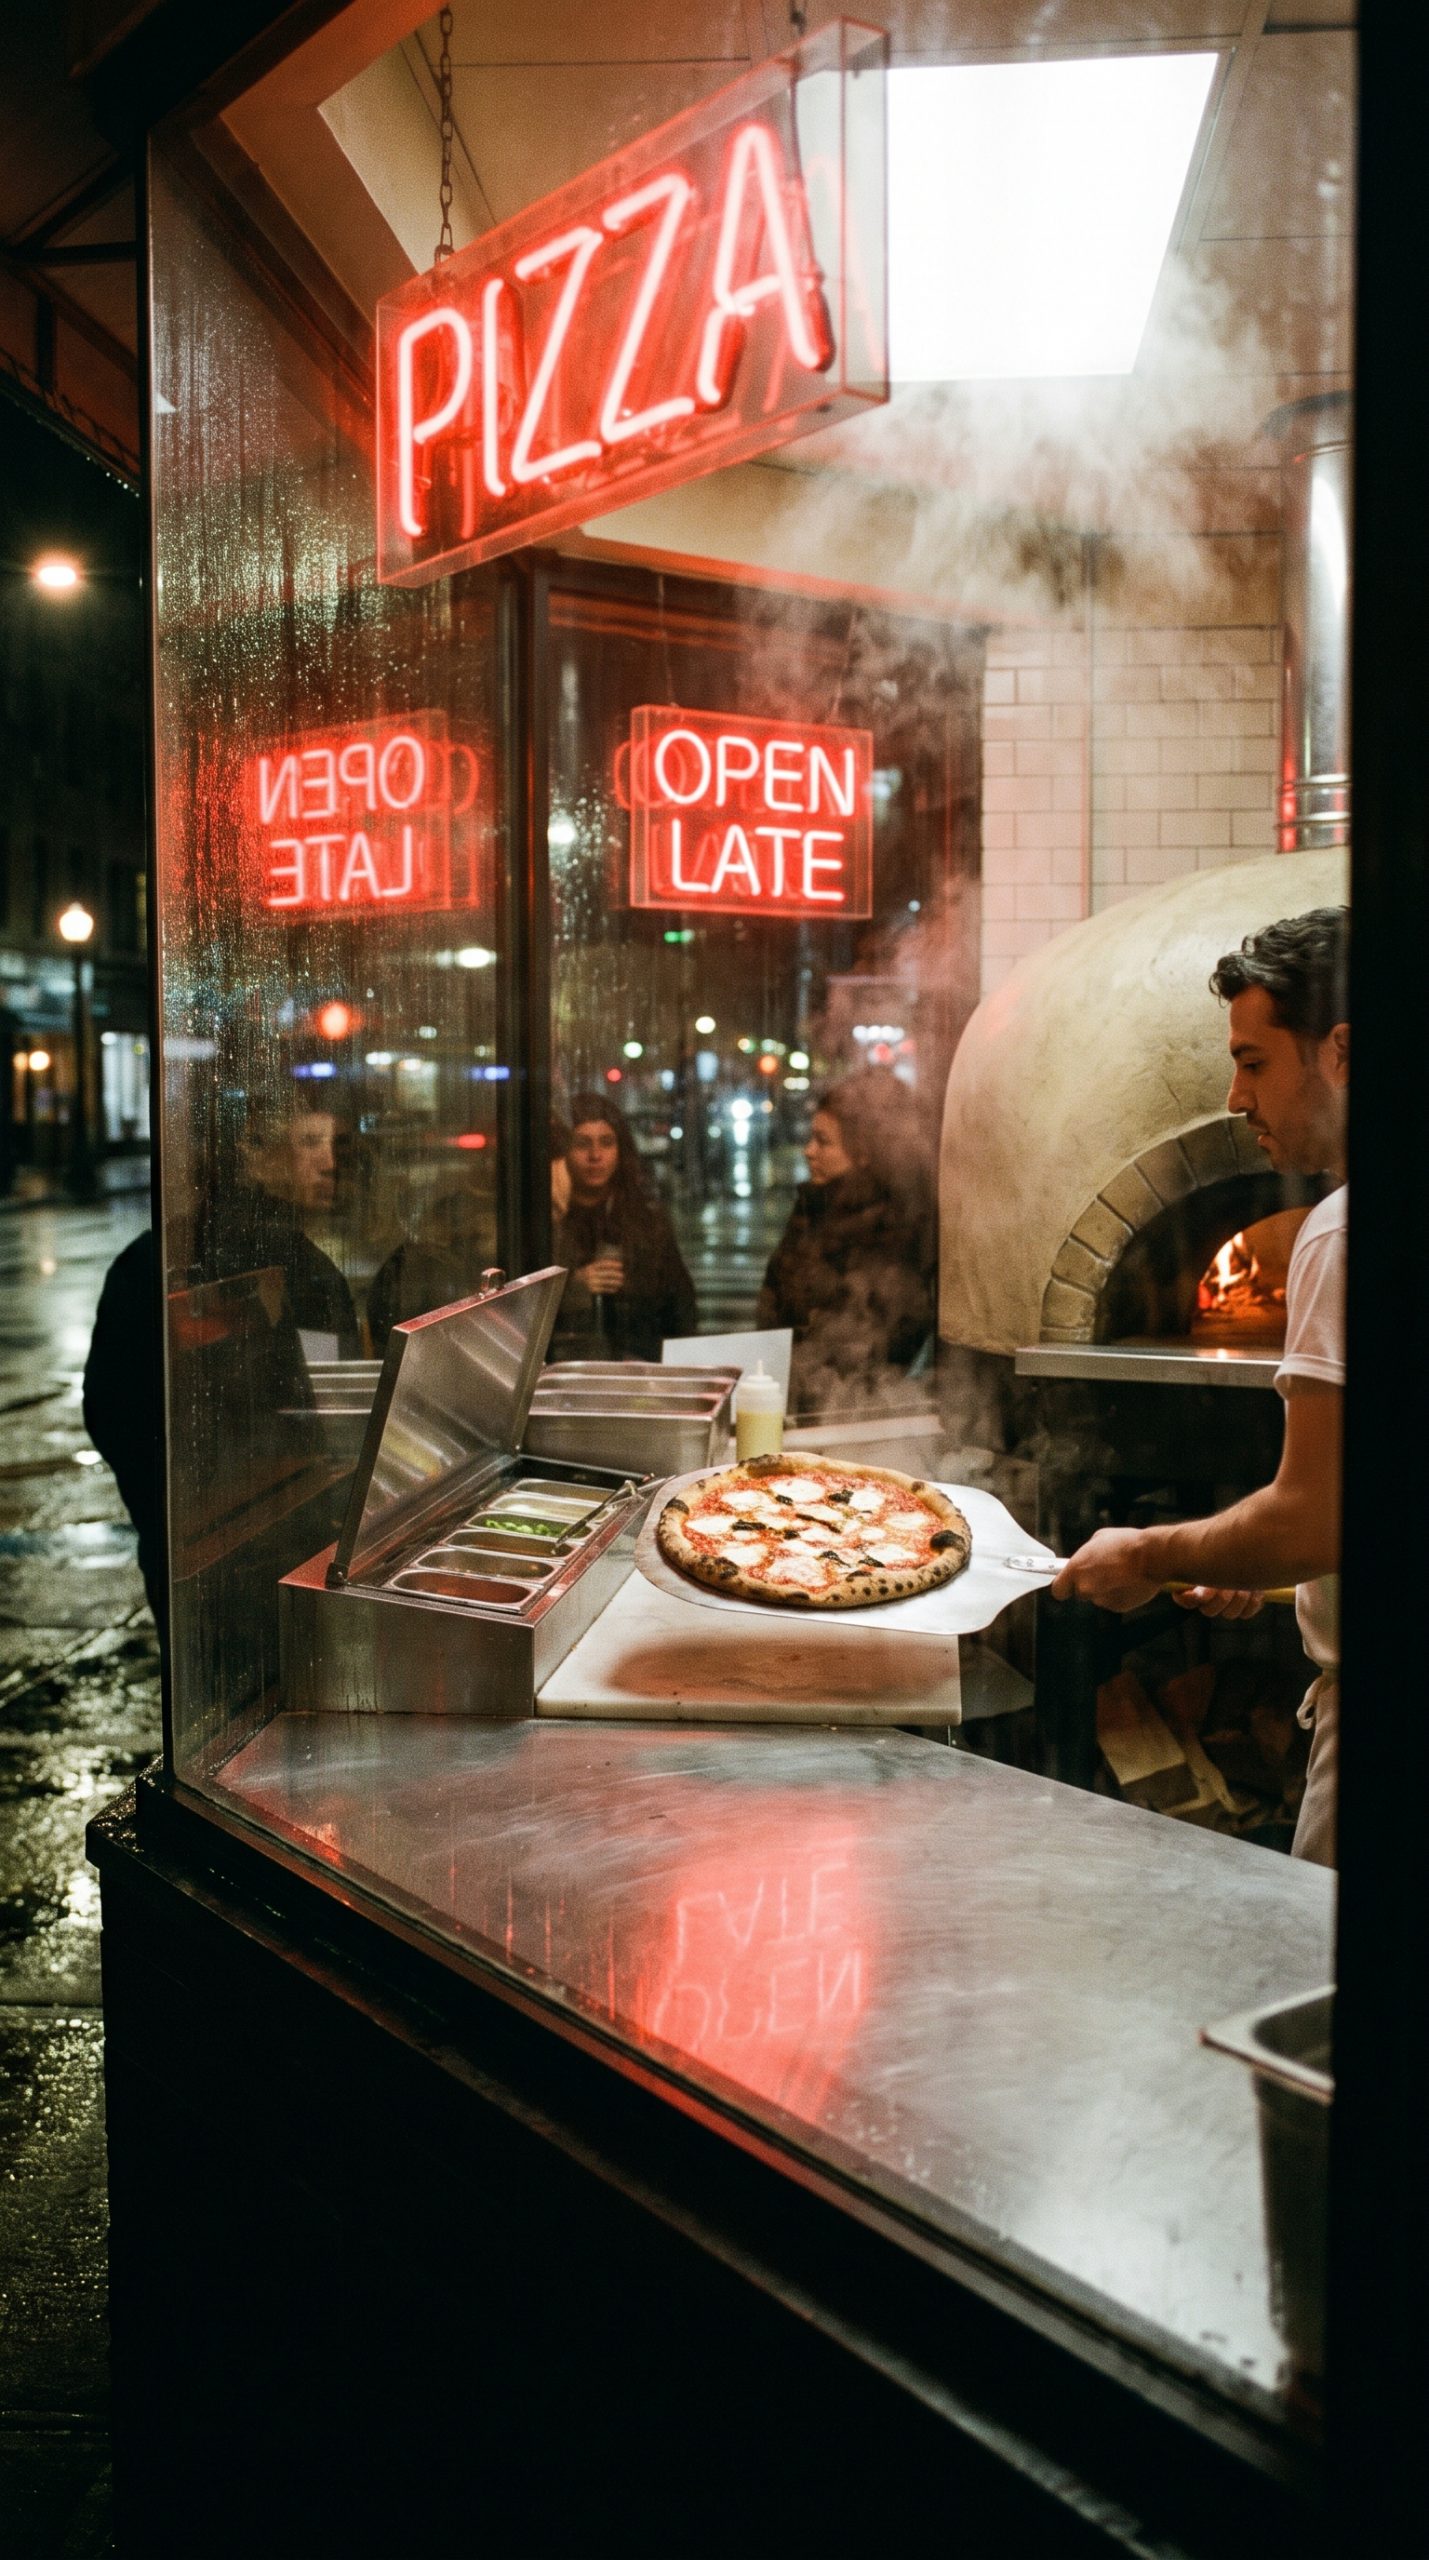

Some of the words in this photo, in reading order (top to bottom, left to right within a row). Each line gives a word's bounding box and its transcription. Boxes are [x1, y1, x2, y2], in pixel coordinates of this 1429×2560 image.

[398, 123, 824, 537] PIZZA
[654, 729, 855, 817] OPEN
[671, 818, 845, 902] LATE
